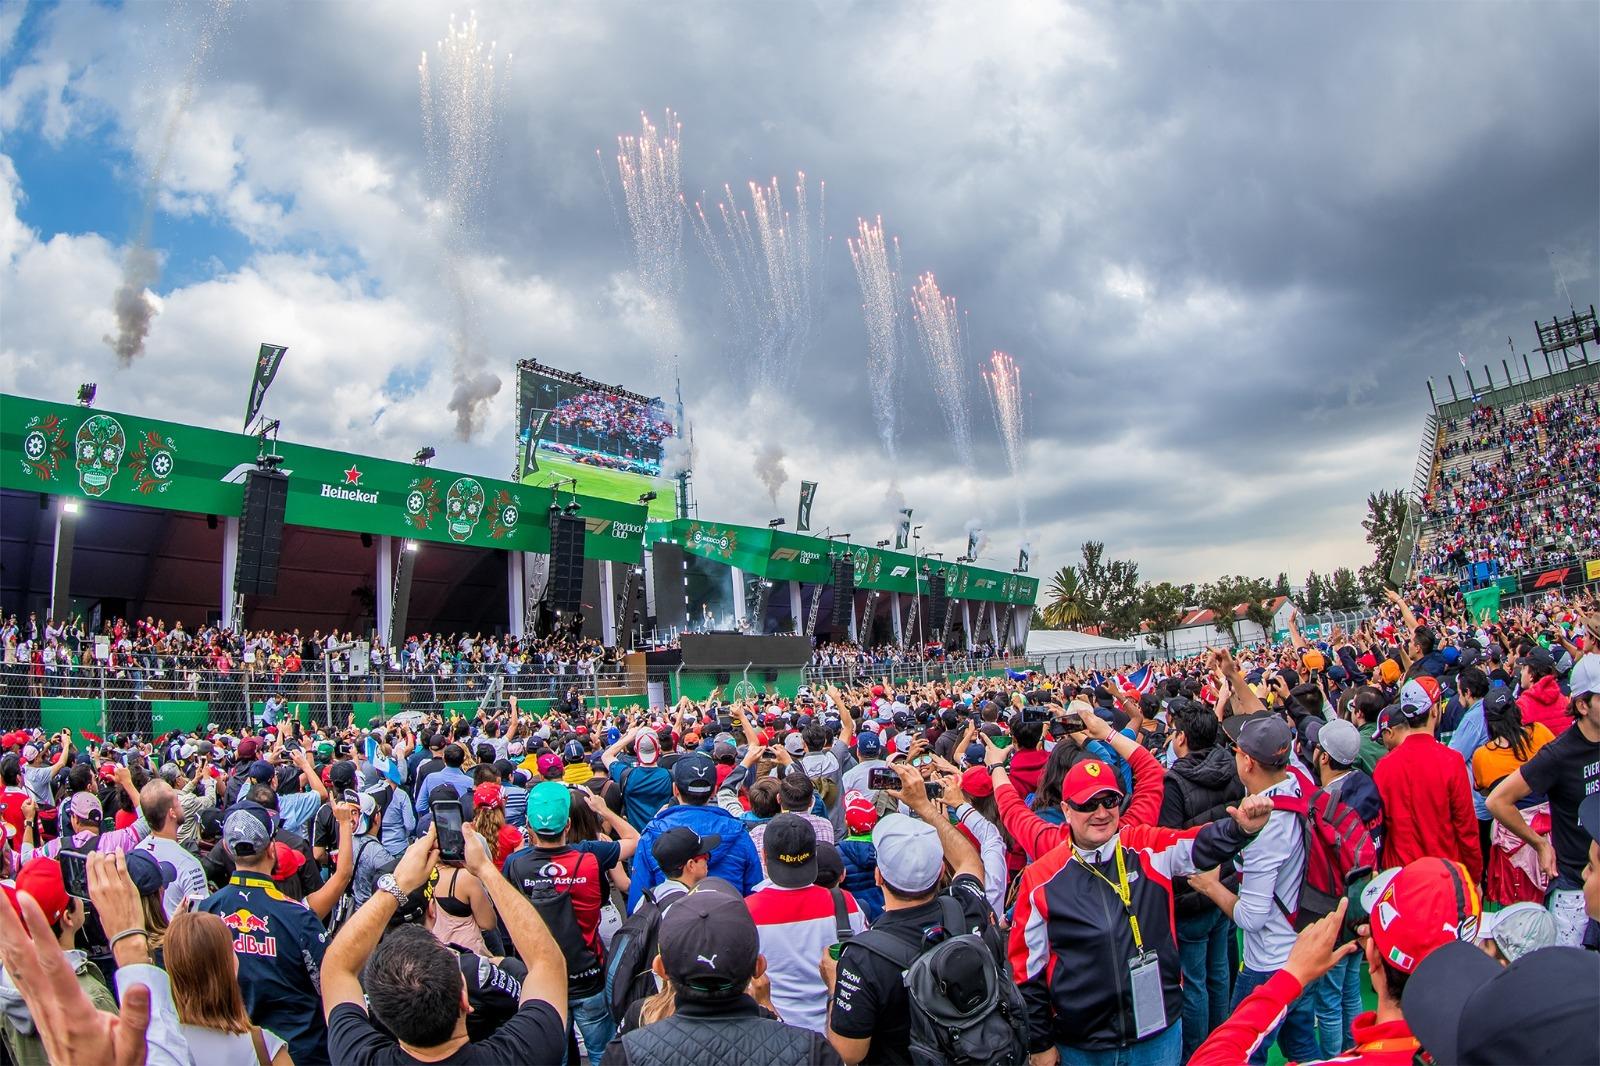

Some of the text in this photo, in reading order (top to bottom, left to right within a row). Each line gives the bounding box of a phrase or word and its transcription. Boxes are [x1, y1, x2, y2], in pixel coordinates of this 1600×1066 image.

[320, 483, 379, 504] Heineken
[612, 520, 644, 533] Paddock
[1533, 567, 1571, 588] F1
[245, 934, 277, 957] Bull
